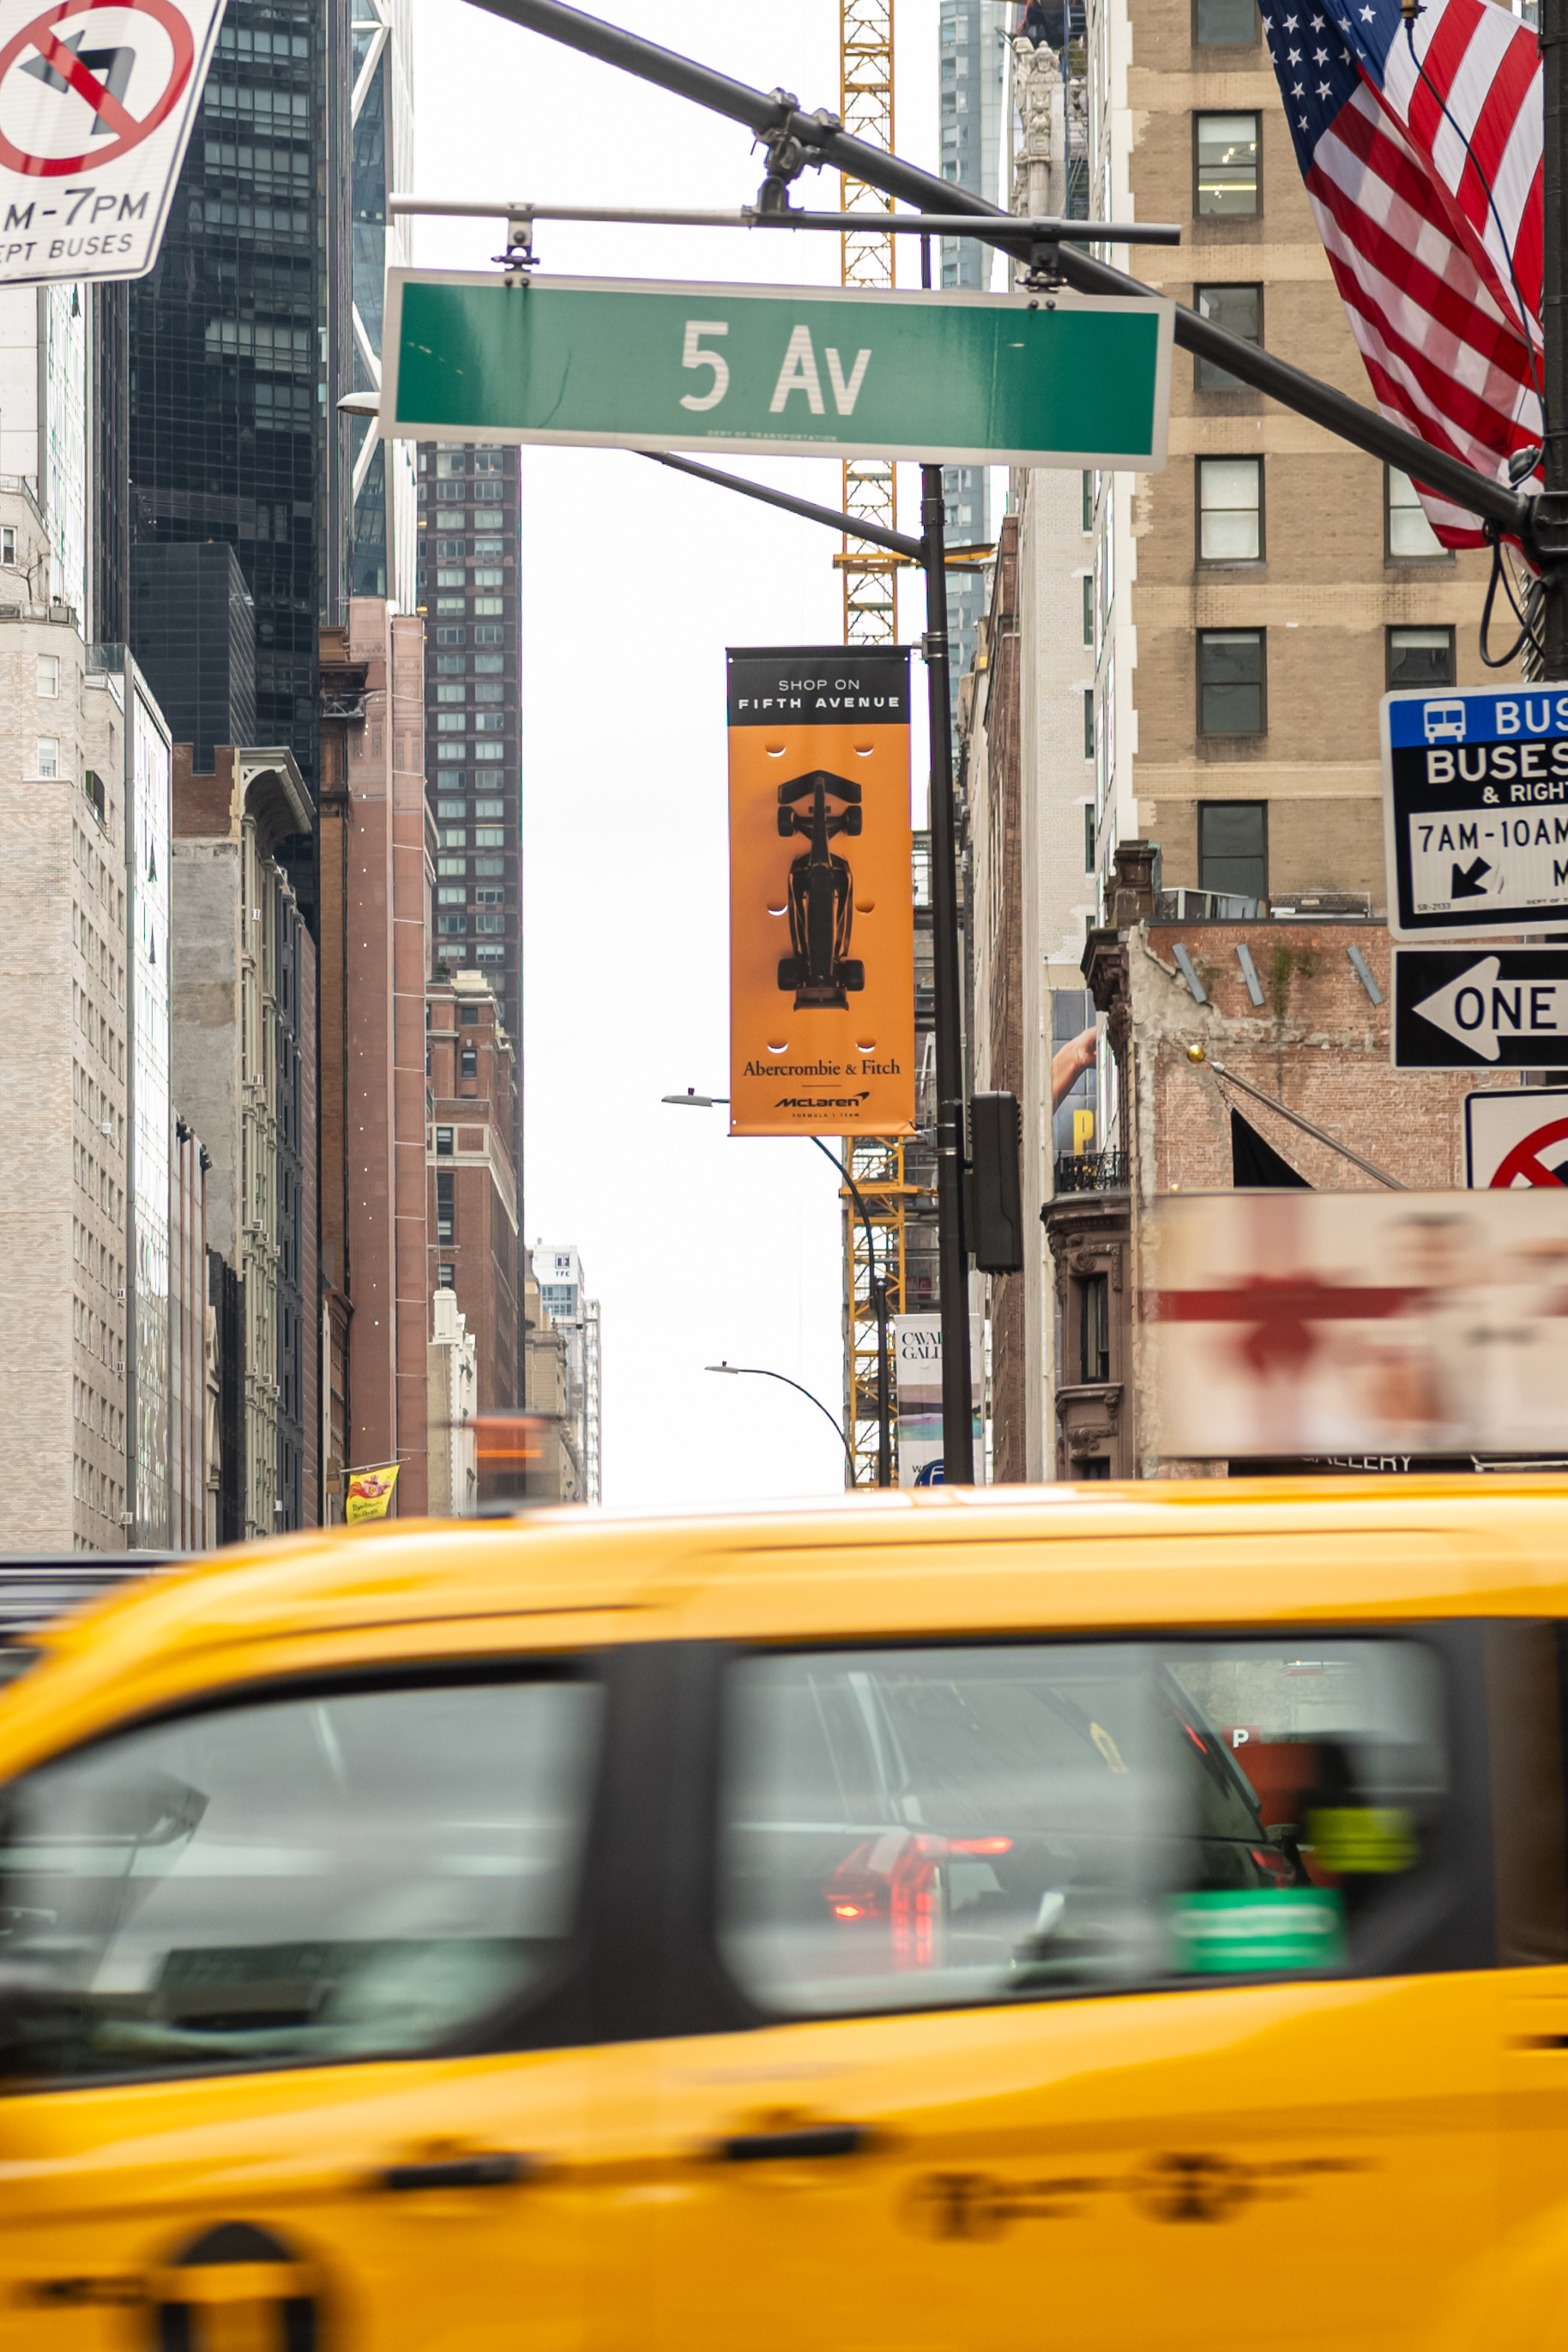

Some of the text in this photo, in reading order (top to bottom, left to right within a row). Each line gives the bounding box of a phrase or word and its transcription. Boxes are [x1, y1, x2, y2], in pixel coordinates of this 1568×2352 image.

[49, 233, 133, 259] BUSES
[679, 320, 872, 416] 5 Av
[751, 432, 837, 442] TRANSPORTATION
[779, 678, 860, 691] SHOP ON
[739, 697, 900, 709] FIFTH AVENUE
[1426, 742, 1568, 784] BUSES
[1482, 786, 1500, 804] &
[1454, 986, 1558, 1031] ONE
[743, 1058, 900, 1076] Abercrombie & Fitch
[774, 1092, 870, 1107] McLaren
[1233, 1728, 1249, 1748] P
